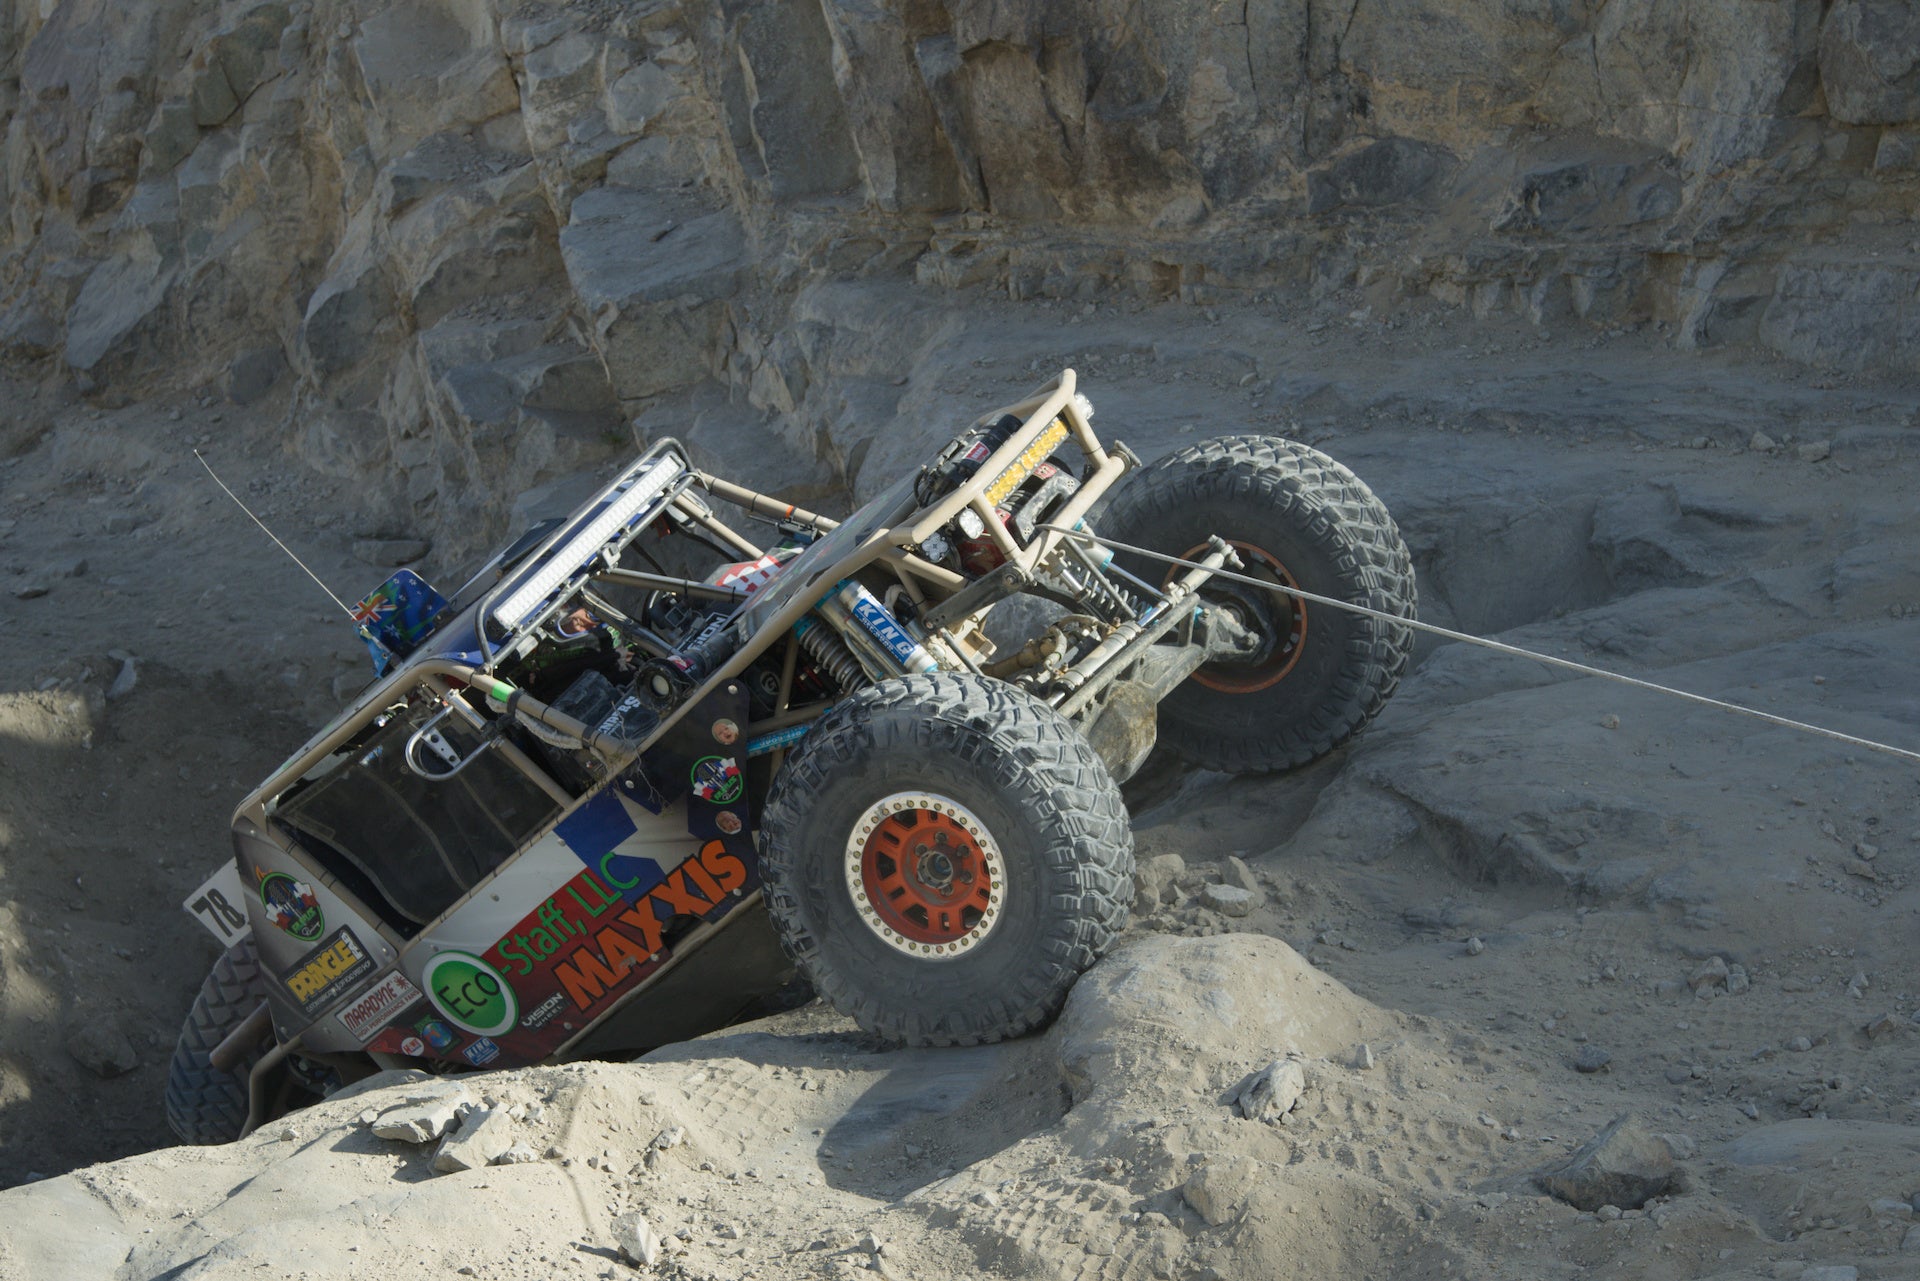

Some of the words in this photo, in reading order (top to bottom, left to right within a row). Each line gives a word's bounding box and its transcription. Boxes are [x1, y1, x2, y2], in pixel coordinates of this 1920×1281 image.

[859, 603, 914, 655] KING
[565, 851, 640, 918] LLC
[191, 888, 246, 937] 78
[551, 839, 747, 1013] MAXXIS
[522, 992, 563, 1026] VISION
[535, 1005, 563, 1028] WHEEL
